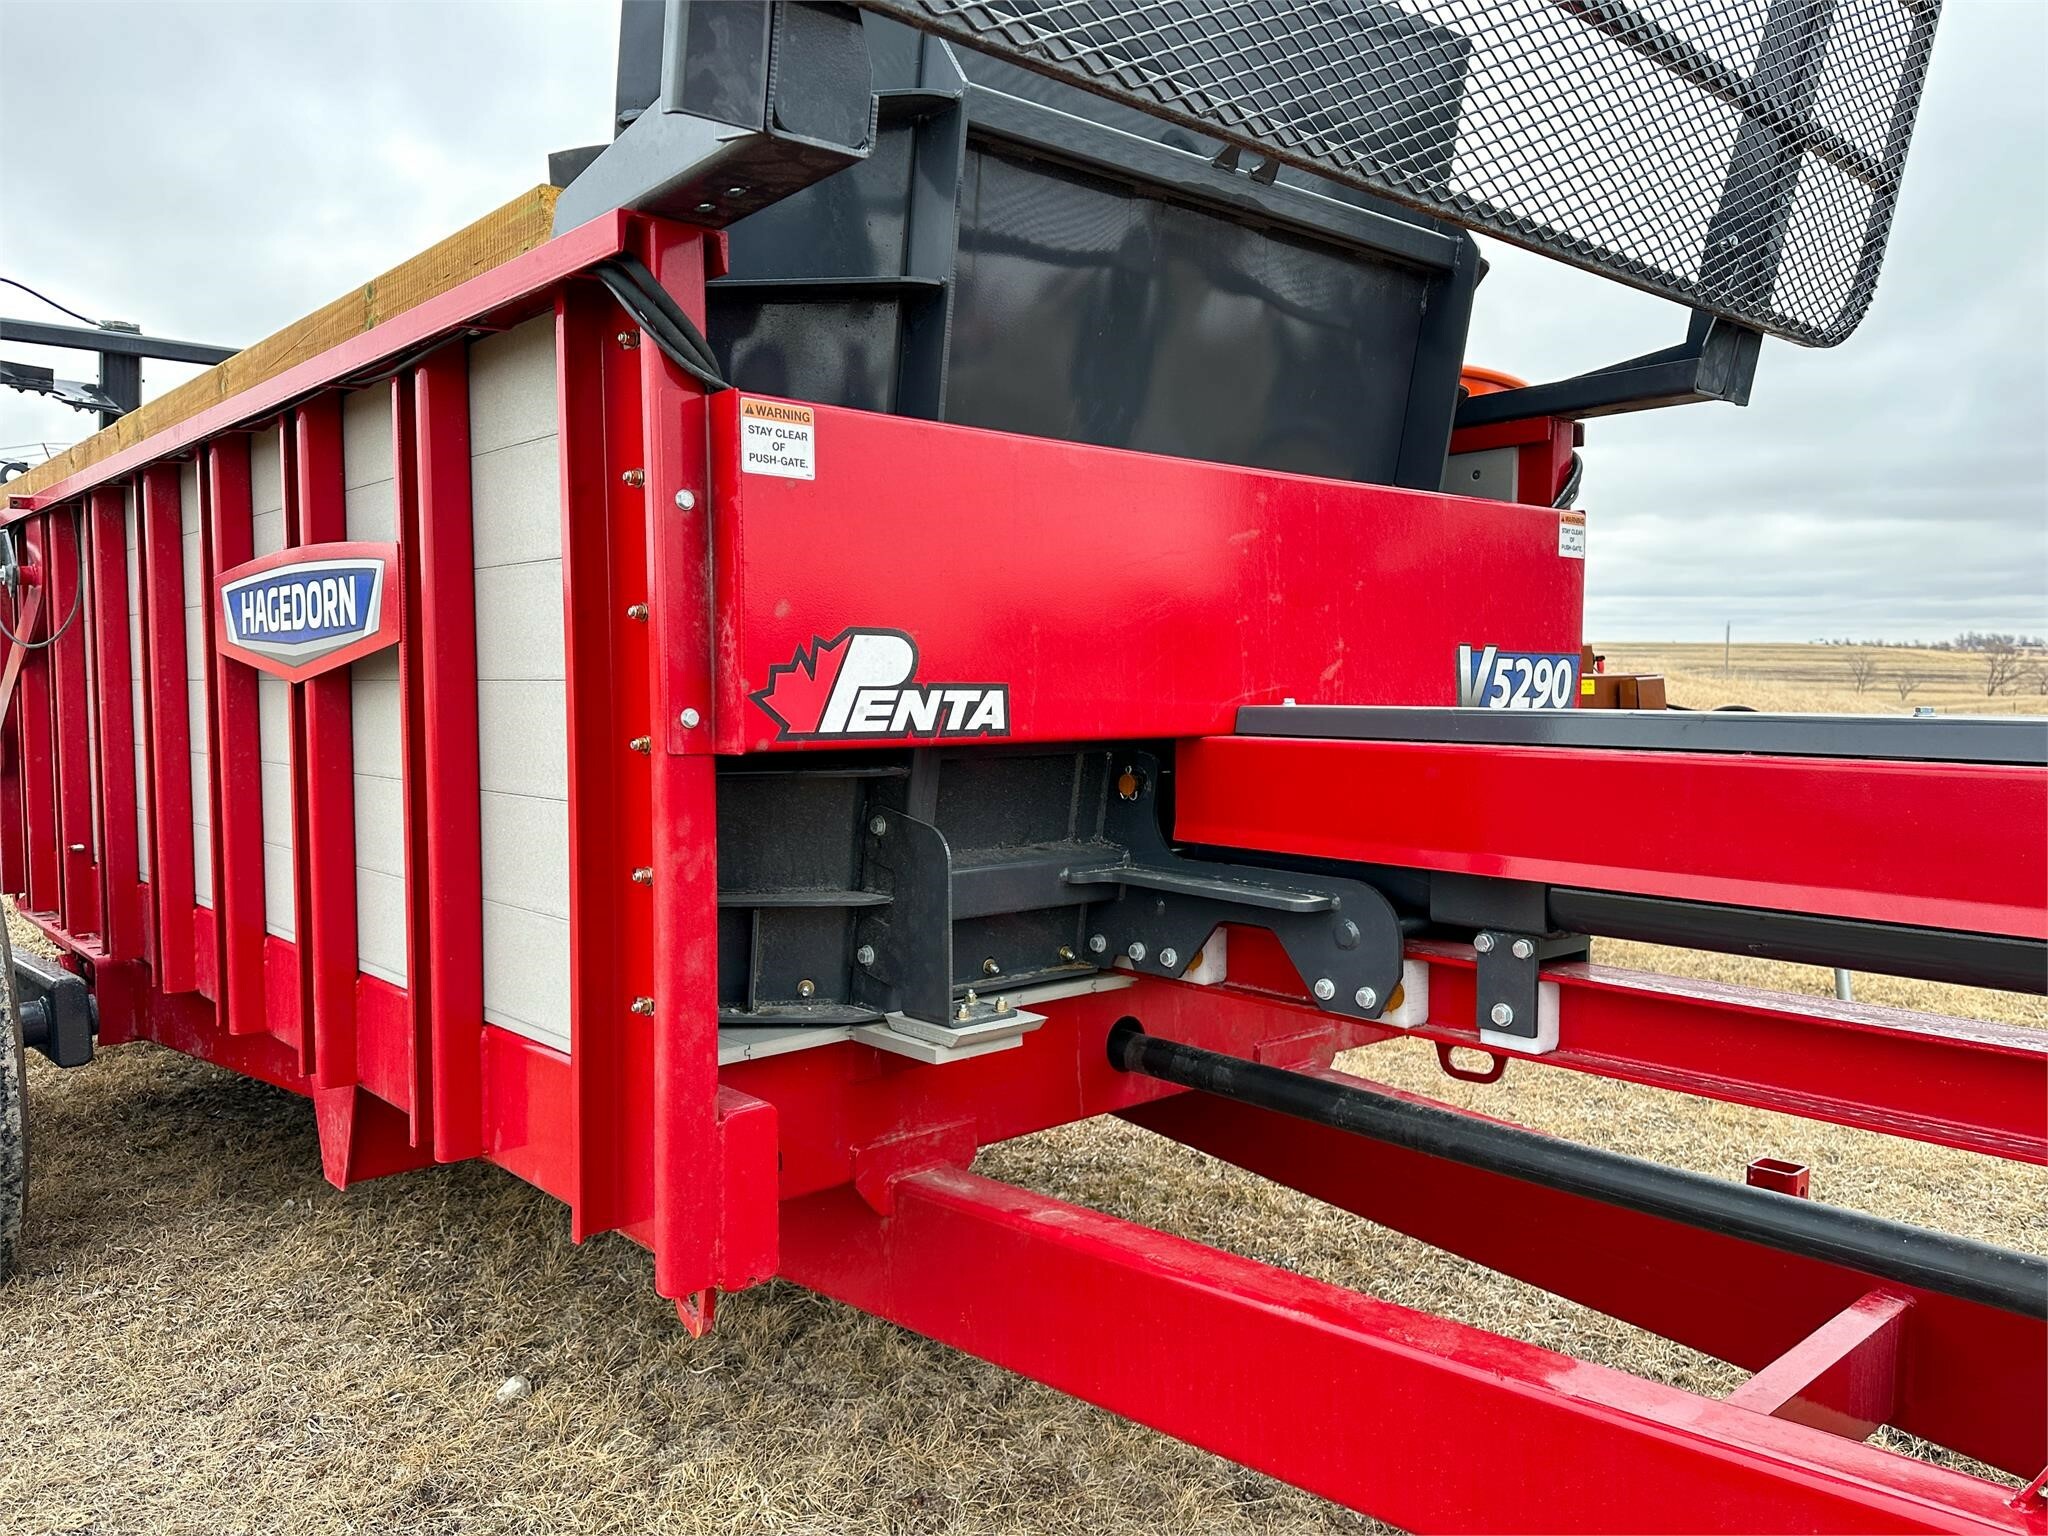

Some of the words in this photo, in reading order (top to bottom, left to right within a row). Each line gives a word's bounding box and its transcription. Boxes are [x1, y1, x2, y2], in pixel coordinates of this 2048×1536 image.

[755, 404, 810, 423] WARNING
[748, 424, 773, 437] STAY
[775, 428, 808, 441] CLEAR
[772, 441, 786, 452] OF
[749, 452, 809, 469] PUSH-GATE.
[240, 575, 357, 635] HAGEDORN
[818, 634, 1006, 733] PENTA
[1459, 645, 1573, 709] V5290
